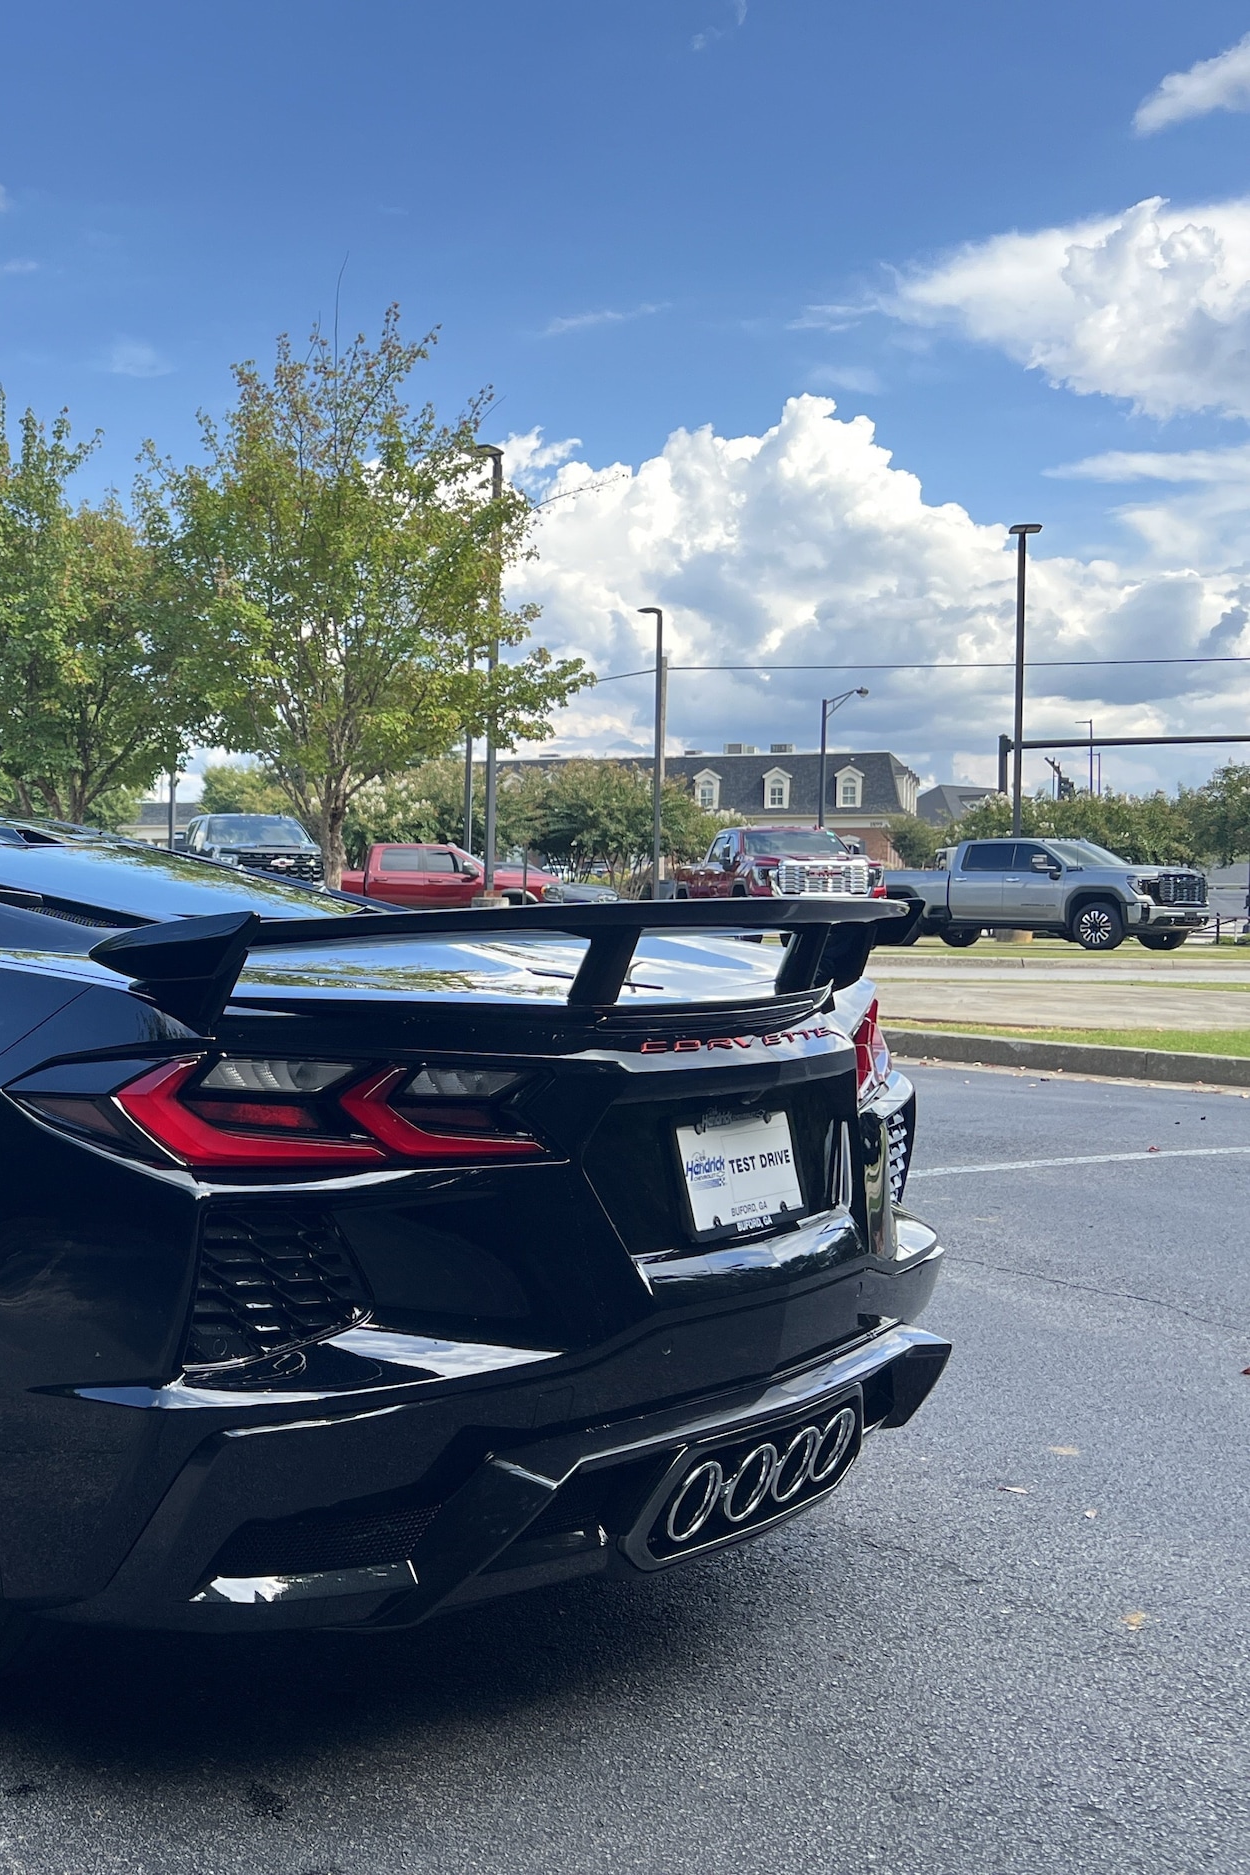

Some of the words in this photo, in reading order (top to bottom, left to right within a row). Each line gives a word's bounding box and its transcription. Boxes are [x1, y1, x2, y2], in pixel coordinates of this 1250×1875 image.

[641, 1026, 830, 1054] CORVETTE
[685, 1156, 725, 1181] Hendrick
[729, 1158, 756, 1174] TEST
[759, 1149, 791, 1169] DRIVE
[730, 1203, 758, 1217] BUFORD,
[758, 1201, 768, 1210] GA
[736, 1217, 763, 1232] BUFORD,
[762, 1216, 773, 1226] GA
